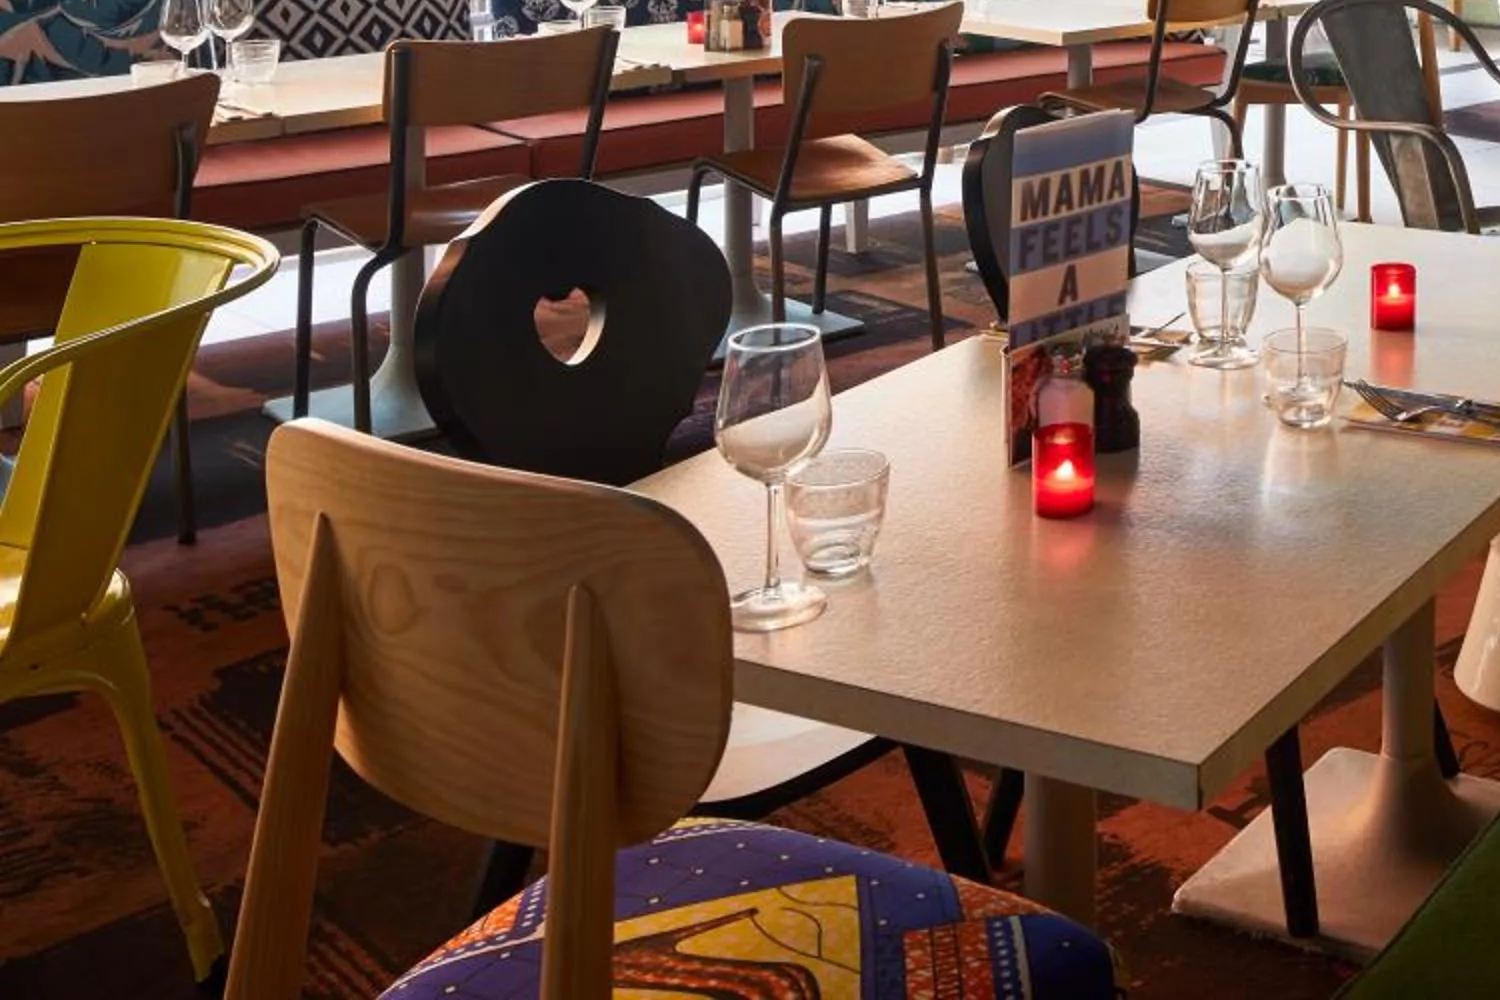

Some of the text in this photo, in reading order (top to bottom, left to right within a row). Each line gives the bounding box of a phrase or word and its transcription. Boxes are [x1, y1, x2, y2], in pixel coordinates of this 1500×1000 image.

[1020, 160, 1125, 222] MAMA
[1018, 208, 1124, 271] FEELS
[1058, 263, 1079, 306] A
